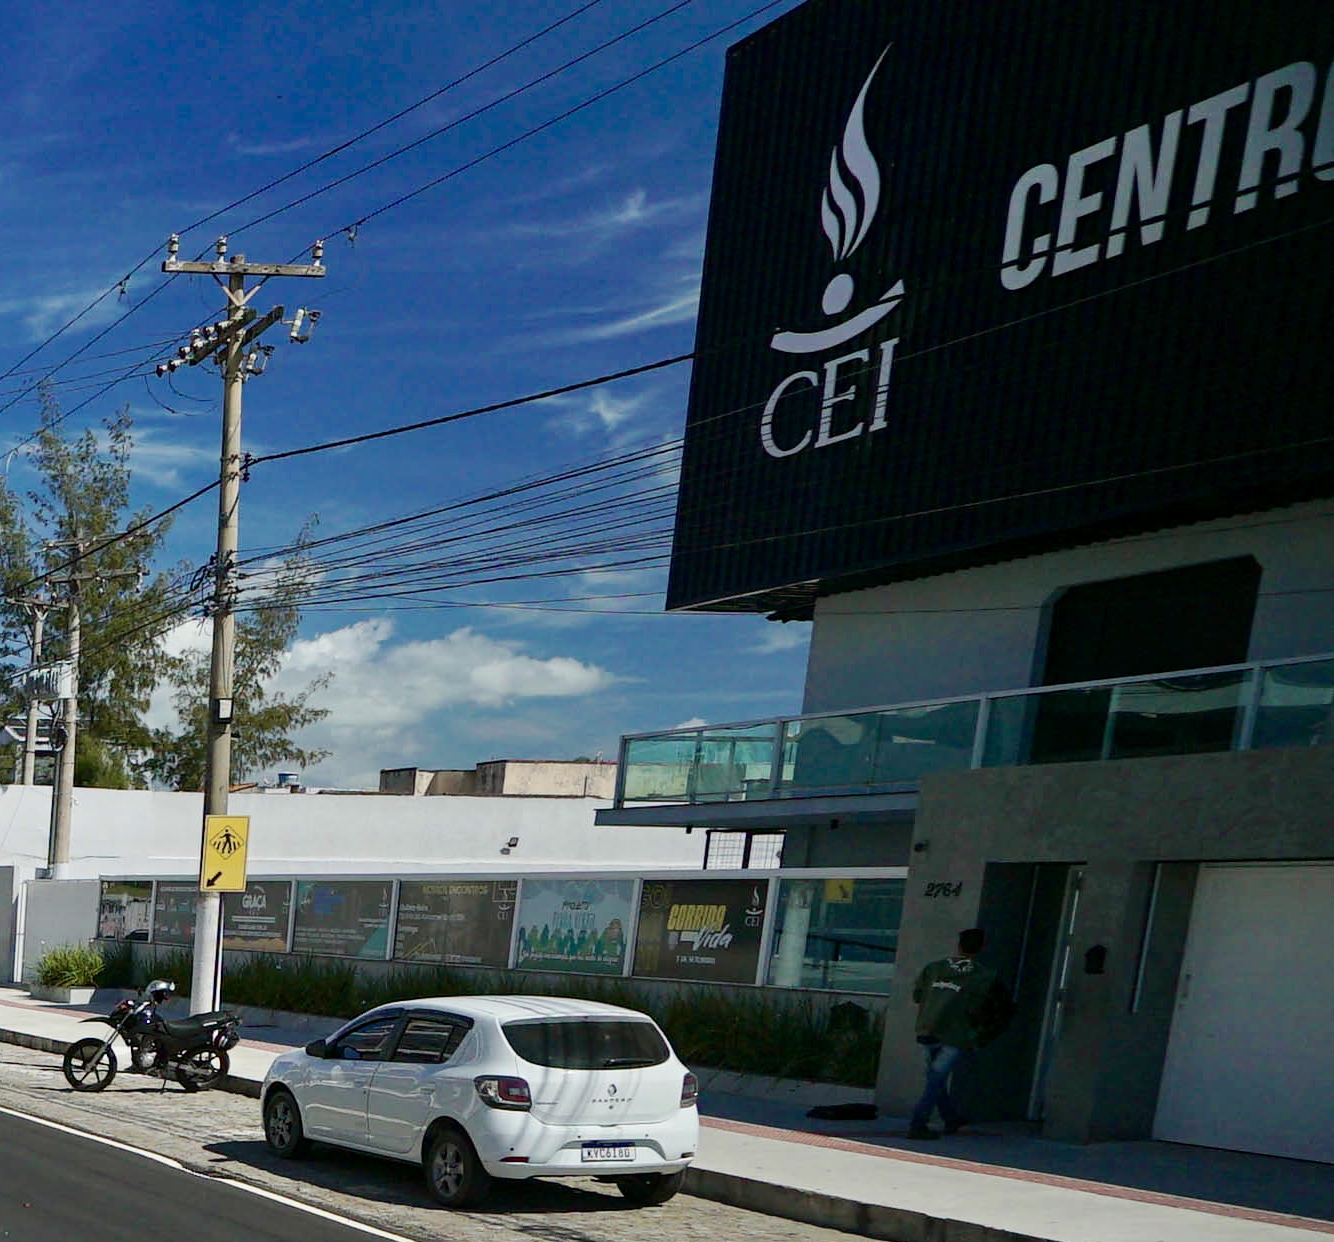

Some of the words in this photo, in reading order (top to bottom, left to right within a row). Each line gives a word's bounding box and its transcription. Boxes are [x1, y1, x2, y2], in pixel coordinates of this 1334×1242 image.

[761, 337, 899, 457] CEI
[924, 881, 963, 898] 2764
[667, 904, 728, 932] CORRIDA
[744, 916, 761, 928] CEI
[693, 923, 734, 951] Vida
